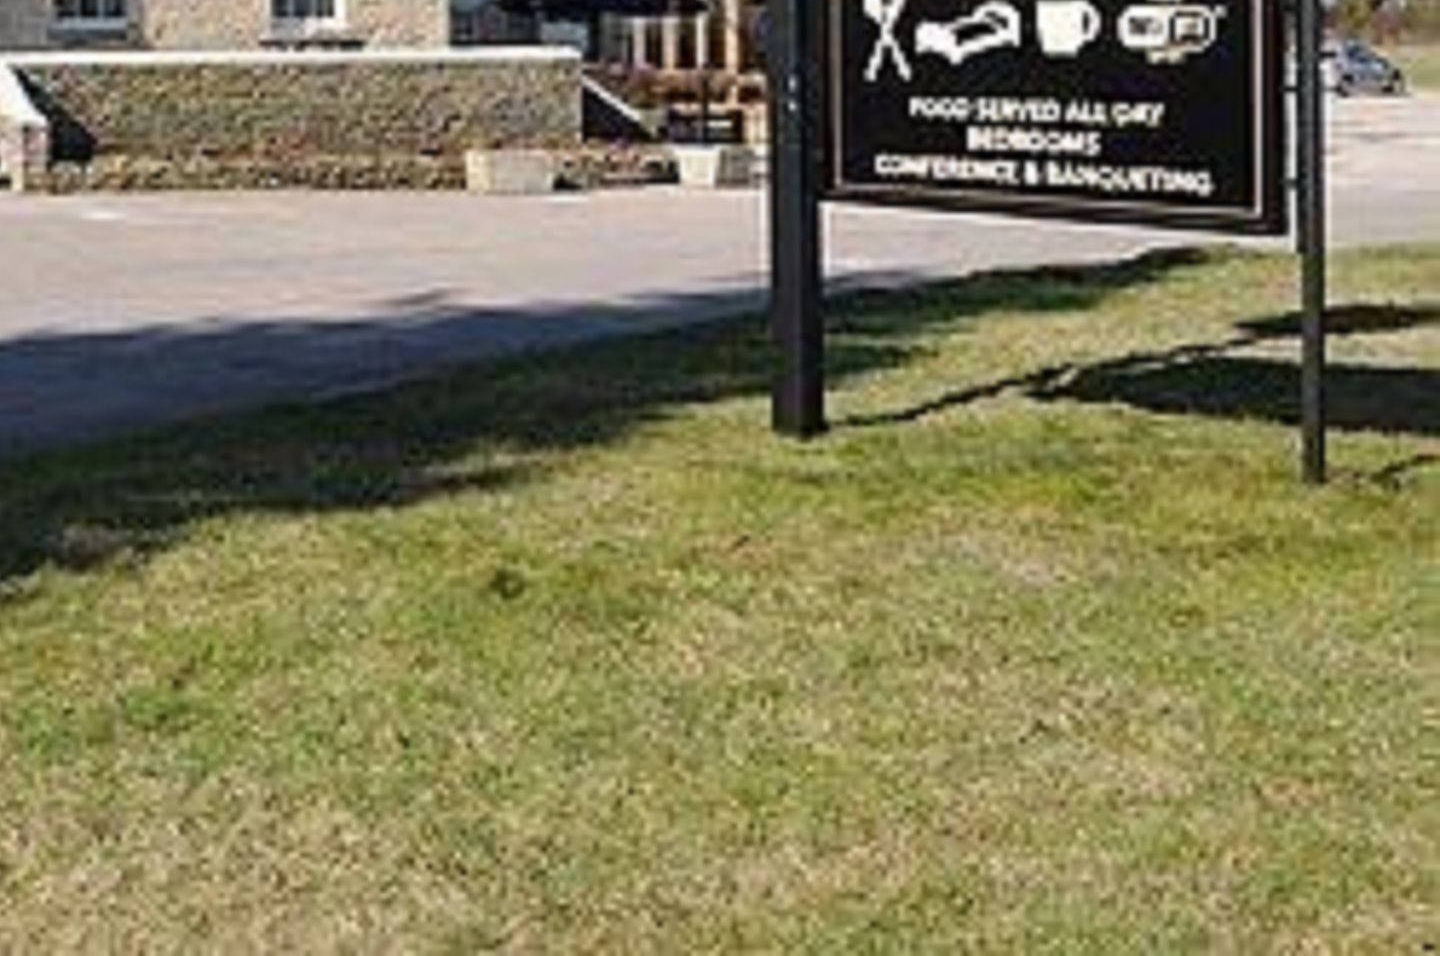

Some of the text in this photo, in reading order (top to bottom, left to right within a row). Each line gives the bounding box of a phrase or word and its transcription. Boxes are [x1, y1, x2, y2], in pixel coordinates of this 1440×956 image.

[910, 96, 1165, 127] FOOD SERVED ALL DAY
[967, 126, 1101, 156] BEDROOMS
[874, 153, 1018, 185] CONFERENCE
[1047, 162, 1213, 196] BANQUETING
